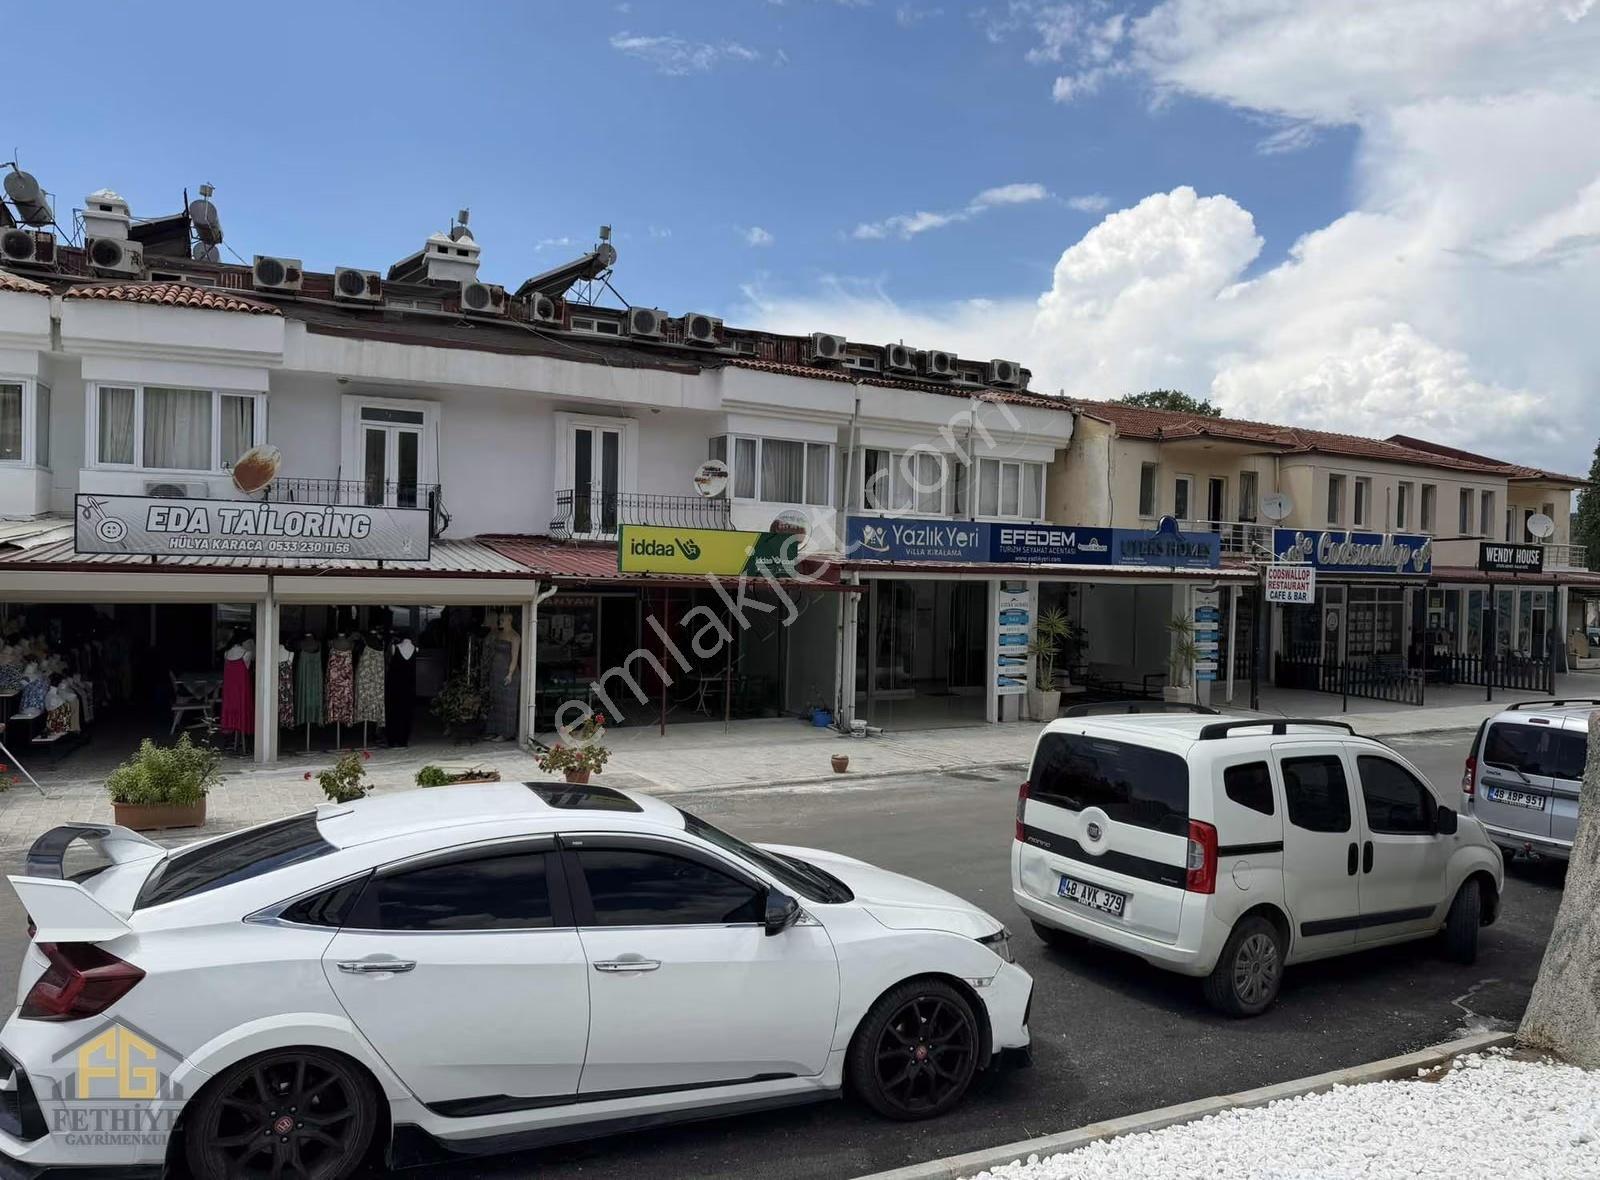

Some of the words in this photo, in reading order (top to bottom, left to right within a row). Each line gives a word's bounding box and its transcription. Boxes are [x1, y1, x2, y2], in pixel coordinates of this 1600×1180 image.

[146, 505, 210, 533] EDA
[169, 535, 209, 549] HÜLYA
[212, 538, 263, 551] KARACA
[268, 540, 298, 552] 0533
[299, 541, 322, 553] 230
[335, 542, 351, 554] 56
[892, 525, 944, 547] Yazlık
[946, 527, 979, 548] Yeri
[1000, 529, 1076, 547] EFEDEM
[631, 538, 675, 556] iddaa
[1486, 547, 1514, 563] WENDY
[1516, 548, 1540, 565] HOUSE
[1267, 580, 1310, 592] RESTAURANT
[1270, 591, 1287, 600] CAFE
[1293, 592, 1307, 600] BAR
[1065, 880, 1078, 896] 48
[1080, 885, 1099, 904] AVK
[1103, 892, 1122, 911] 379
